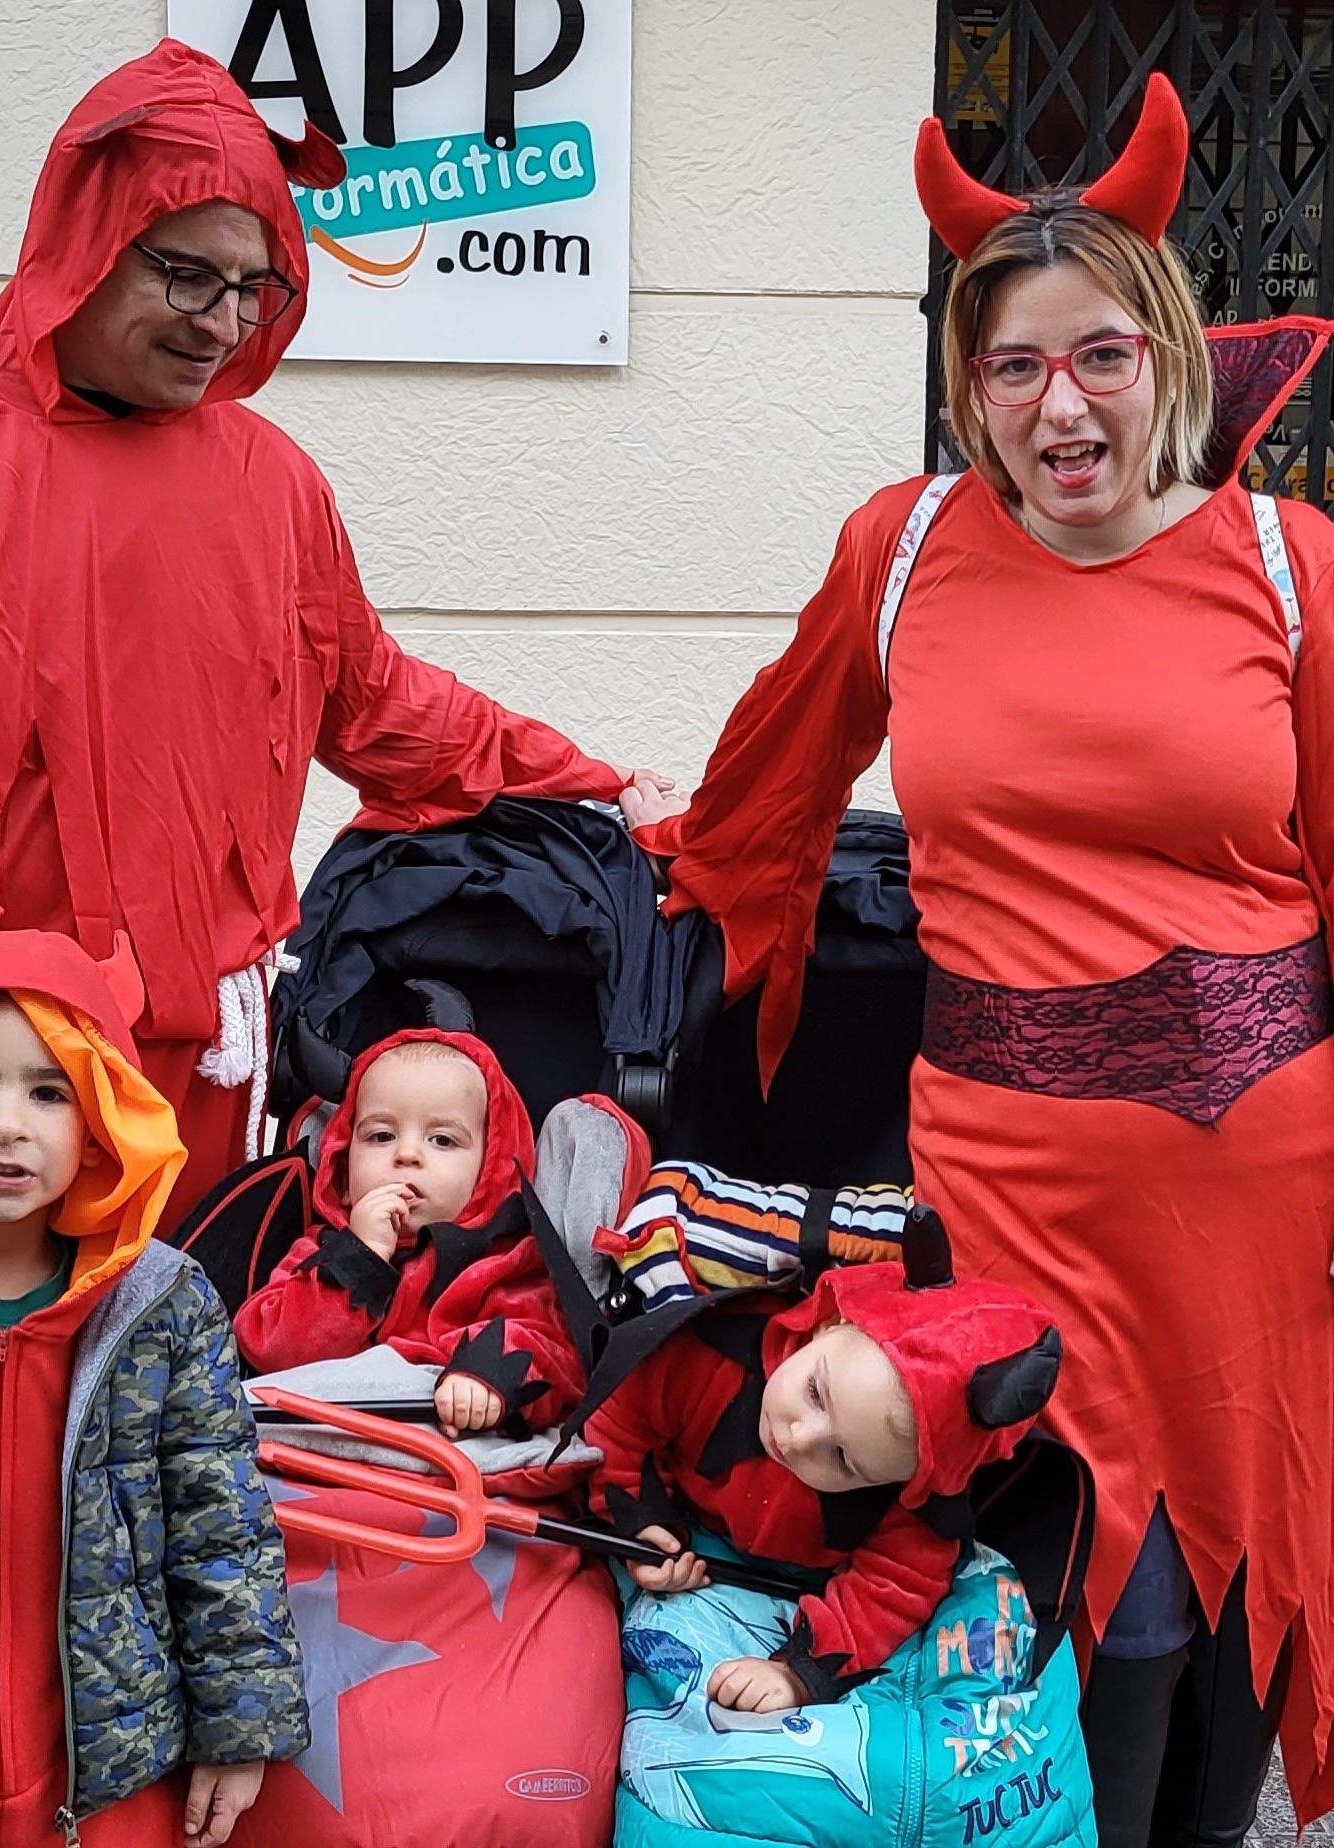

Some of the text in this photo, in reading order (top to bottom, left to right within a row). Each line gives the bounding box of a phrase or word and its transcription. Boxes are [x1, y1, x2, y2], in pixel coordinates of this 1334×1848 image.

[227, 0, 585, 151] APP
[288, 136, 585, 221] ormática
[436, 229, 591, 277] .com
[958, 1757, 1063, 1846] TUC TUC
